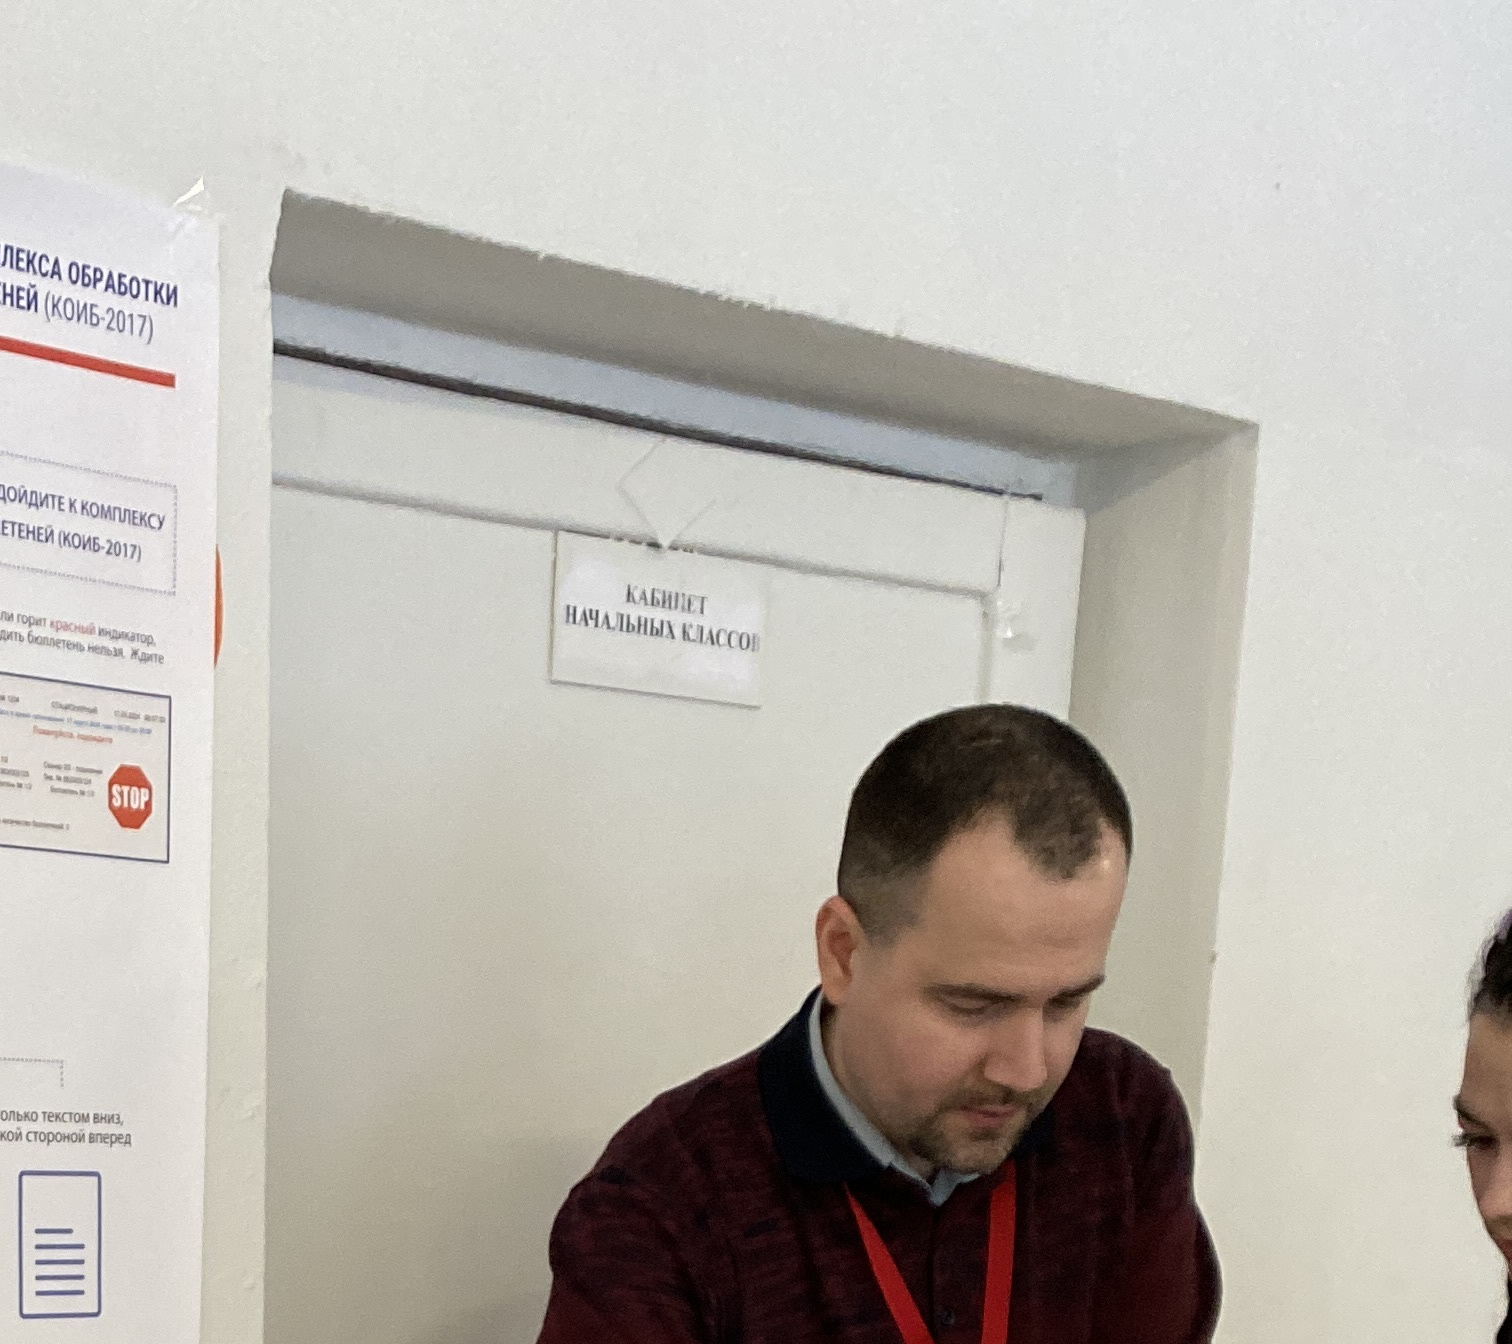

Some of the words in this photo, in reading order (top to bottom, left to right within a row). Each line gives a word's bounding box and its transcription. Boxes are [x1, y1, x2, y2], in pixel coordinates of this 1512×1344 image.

[68, 261, 178, 308] ОБРАБОТКИ
[44, 290, 154, 344] (КОИБ-2017)
[69, 497, 78, 514] К
[81, 499, 166, 531] КОМПЛЕКСУ
[58, 532, 142, 563] (КОИБ-2017)
[626, 583, 708, 616] КАБИНЕТ
[16, 612, 47, 628] горит
[50, 618, 96, 636] красный
[565, 604, 676, 640] НАЧАЛЬНЫХ
[27, 630, 85, 652] бюллетень
[111, 784, 150, 810] STOP
[42, 1110, 90, 1125] текстом
[93, 1112, 124, 1126] вниз,
[26, 1128, 85, 1146] стороной
[89, 1132, 132, 1148] вперед
